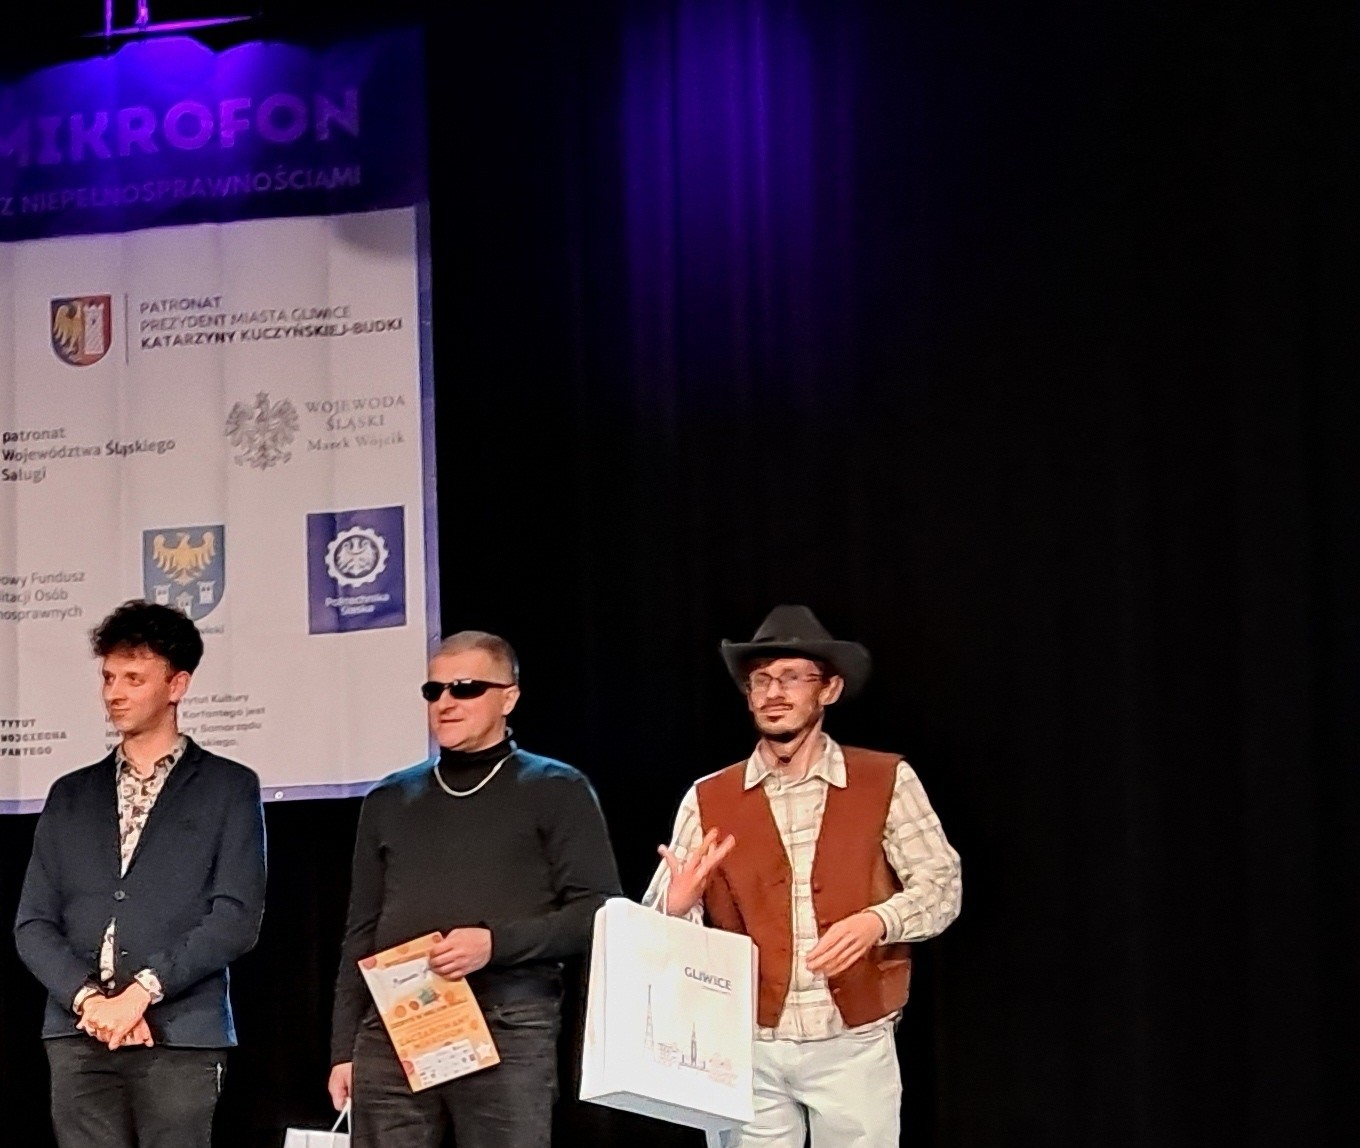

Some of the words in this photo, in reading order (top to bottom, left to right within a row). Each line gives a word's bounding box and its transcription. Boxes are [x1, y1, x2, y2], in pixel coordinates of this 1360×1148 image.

[0, 197, 14, 215] Z
[140, 296, 222, 314] PATRONAT
[140, 314, 227, 332] PREZYDENT
[231, 309, 286, 325] MIASTA
[291, 305, 352, 320] GLIWICE
[141, 331, 236, 349] KATARZYNY
[240, 317, 404, 341] KUCZYŃSKIEJ-BUDKI
[305, 395, 405, 413] WOJEWODA
[2, 426, 66, 445] patronat
[2, 442, 102, 464] Województwa
[106, 437, 176, 458] Śląskiego
[2, 467, 47, 485] Saługi
[31, 571, 85, 585] Fundusz
[34, 588, 68, 602] Osób
